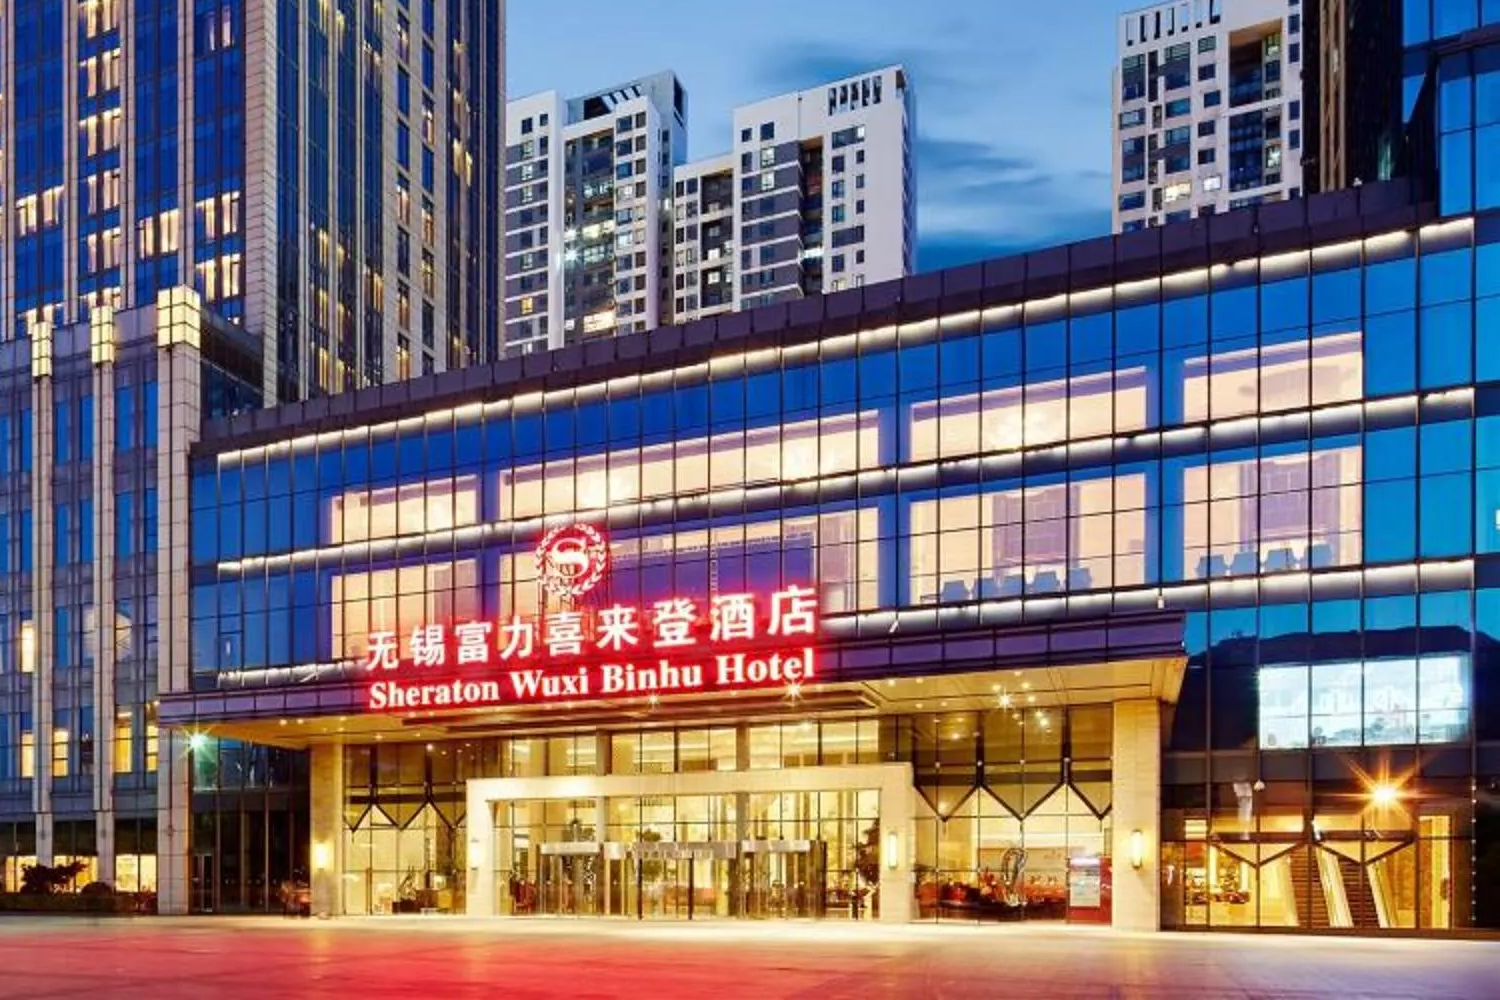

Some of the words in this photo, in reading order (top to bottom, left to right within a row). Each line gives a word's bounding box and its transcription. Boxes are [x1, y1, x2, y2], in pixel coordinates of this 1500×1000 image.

[551, 537, 589, 577] S
[366, 585, 817, 670] 无锡富力喜来登酒店
[369, 679, 499, 709] Sheraton
[510, 667, 588, 698] Wuxi
[601, 659, 703, 693] Binhu
[716, 648, 814, 684] Hotel
